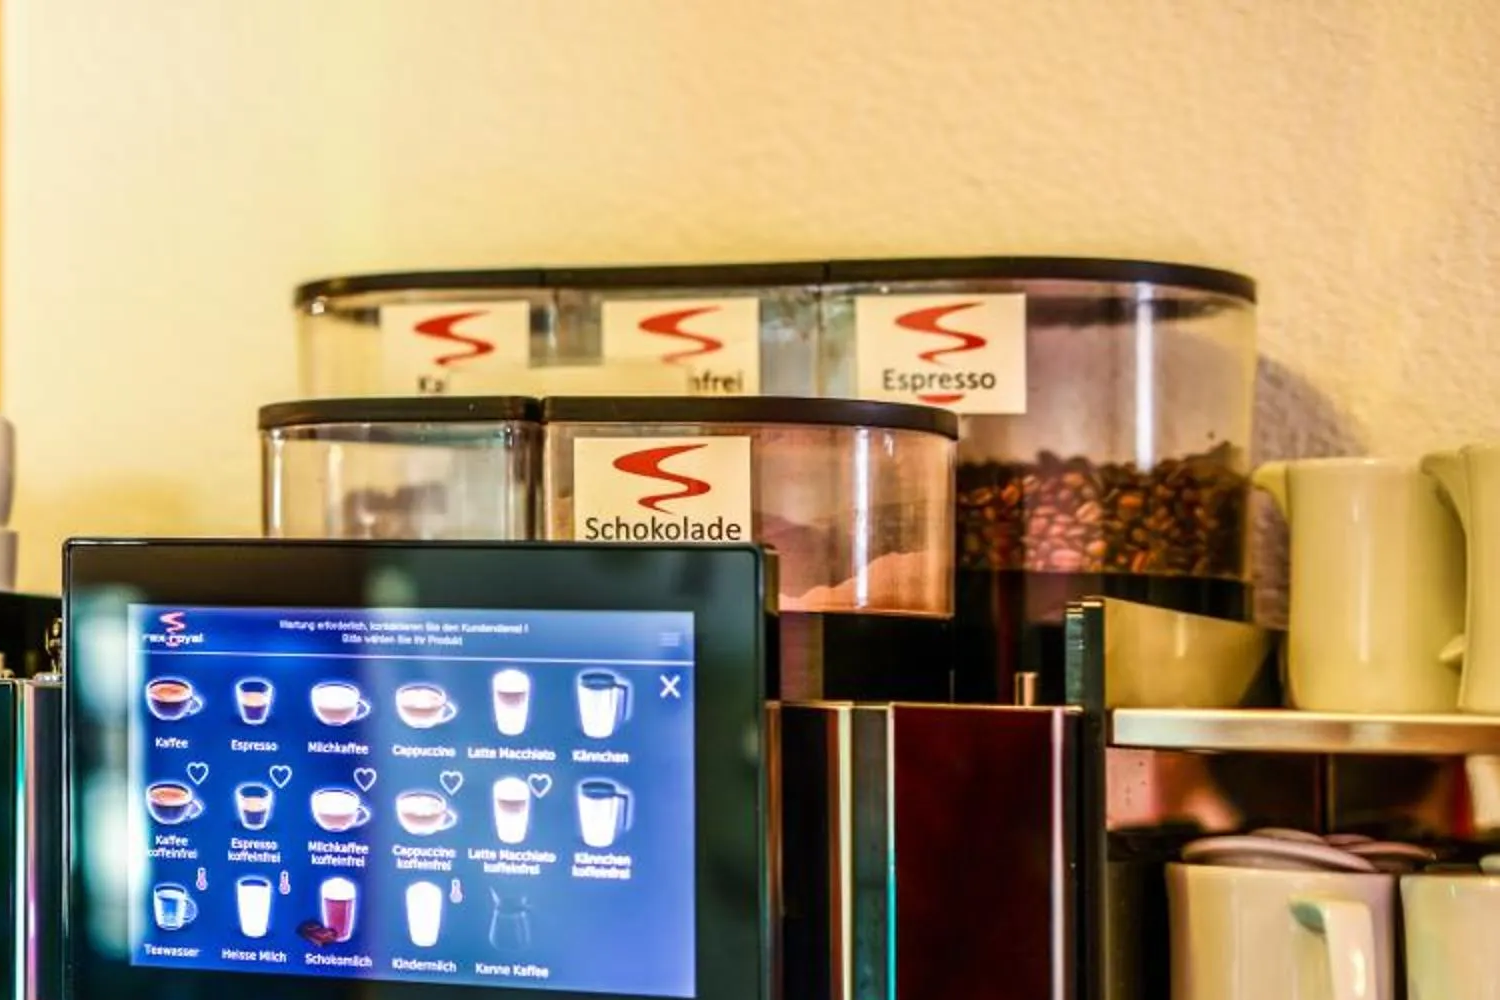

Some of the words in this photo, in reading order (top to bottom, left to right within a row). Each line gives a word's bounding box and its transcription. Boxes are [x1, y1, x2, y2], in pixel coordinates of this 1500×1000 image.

[882, 368, 996, 393] Espresso
[585, 517, 742, 541] Schokolade
[155, 737, 188, 749] Kaffee
[231, 739, 278, 752] Espresso
[308, 741, 369, 754] Milchkaffee
[392, 745, 456, 759] Cappuccino
[468, 747, 496, 758] Latte
[499, 748, 556, 761] Macchiato
[155, 835, 189, 847] Kaffee
[231, 838, 278, 851] Espresso
[308, 841, 369, 854] Milchkaffee
[228, 850, 280, 863] koffeinfrei
[392, 844, 456, 858] Cappuccino
[468, 848, 496, 860] Latte
[499, 848, 557, 863] Macchiato
[311, 853, 365, 867] koffeinfrei
[144, 944, 200, 957] Teewasser
[222, 948, 257, 961] Heisse
[259, 950, 287, 963] Milch
[305, 953, 372, 968] Schokomilch
[392, 958, 457, 972] Kindermilch
[476, 962, 510, 976] Kanne
[514, 964, 549, 978] Kaffee
